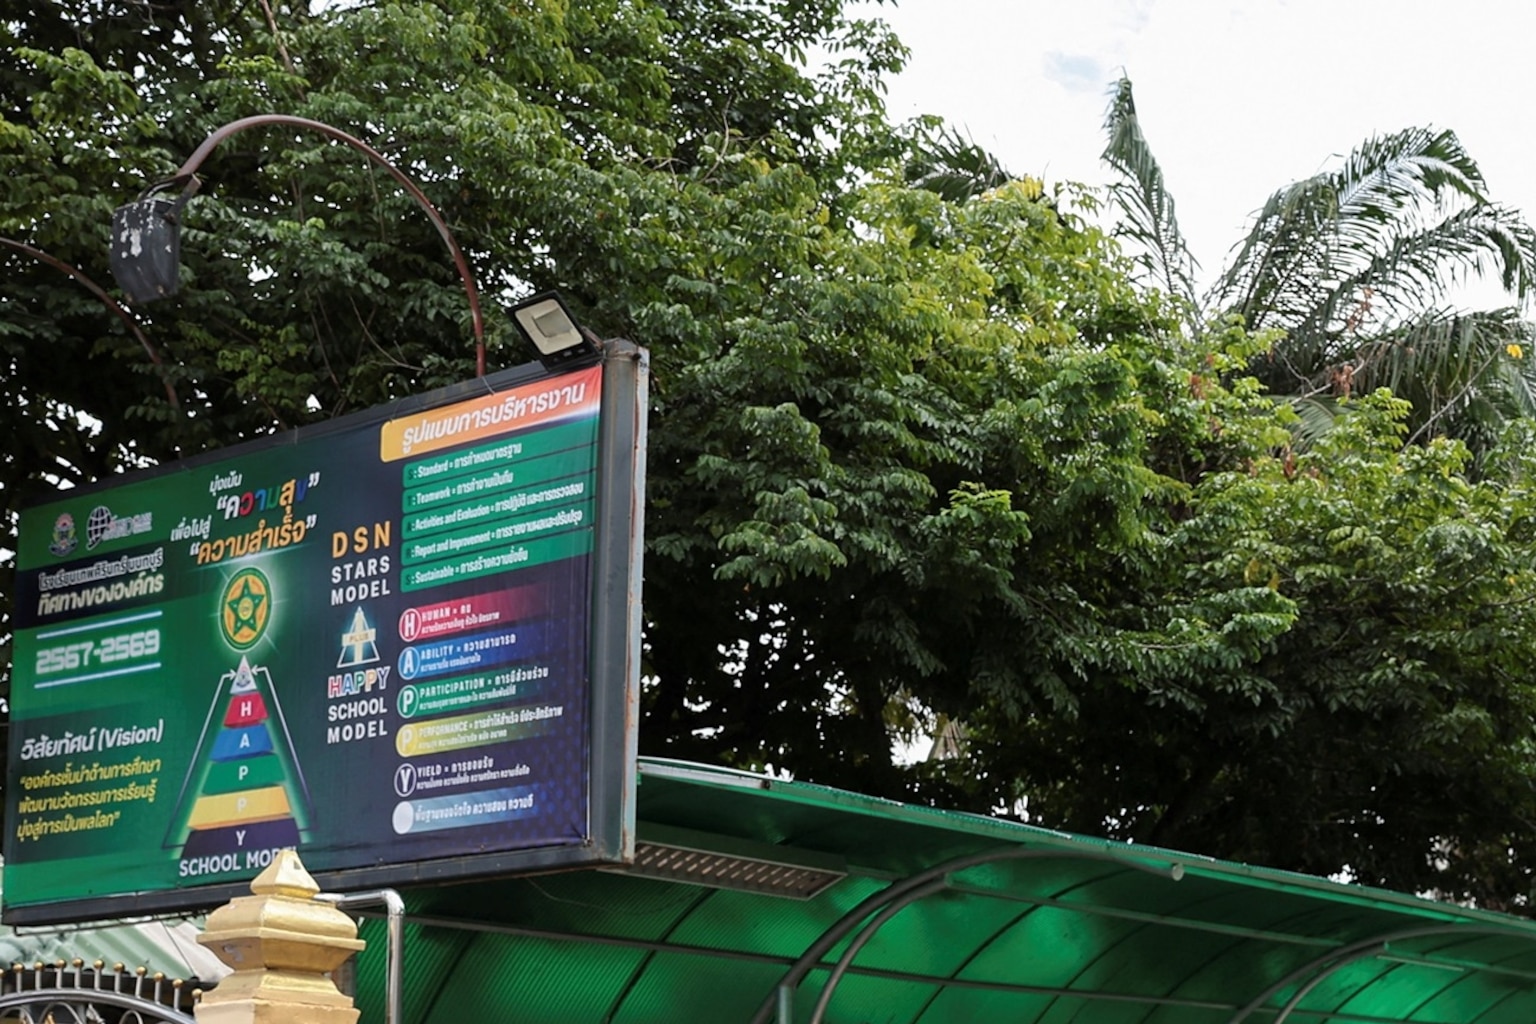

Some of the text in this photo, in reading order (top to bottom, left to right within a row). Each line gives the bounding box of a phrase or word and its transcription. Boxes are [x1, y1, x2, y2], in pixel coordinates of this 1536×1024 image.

[402, 383, 585, 455] รูปแบบการบริหารงาน
[418, 461, 448, 478] Standard
[209, 471, 242, 496] มุ่งเน้น
[416, 485, 451, 505] Teamwork
[170, 514, 212, 541] เพื่อไปสู่
[445, 510, 456, 524] and
[414, 542, 437, 559] Report
[437, 538, 449, 552] and
[449, 530, 491, 553] Improvement
[331, 556, 390, 584] STARS
[415, 565, 454, 584] Sustainable
[37, 572, 164, 616] ทิศทางขององค์กร
[331, 579, 390, 605] MODEL
[404, 613, 415, 637] H
[421, 606, 450, 622] HUMAN
[36, 629, 160, 674] 2567-2569
[403, 650, 414, 674] A
[421, 645, 454, 660] ABILITY
[328, 666, 391, 699] HAPPY
[403, 690, 414, 713] P
[420, 678, 485, 698] PARTICIPATION
[240, 701, 252, 717] H
[328, 697, 387, 721] SCHOOL
[21, 718, 164, 760] วิสัยทัศน์ (Vision)
[239, 733, 250, 749] A
[327, 719, 387, 744] MODEL
[419, 720, 468, 737] PERFORMANCE
[238, 765, 248, 780] P
[400, 768, 411, 793] Y
[417, 764, 442, 779] YIELD
[237, 798, 247, 813] P
[236, 830, 246, 846] Y
[179, 854, 241, 877] SCHOOL
